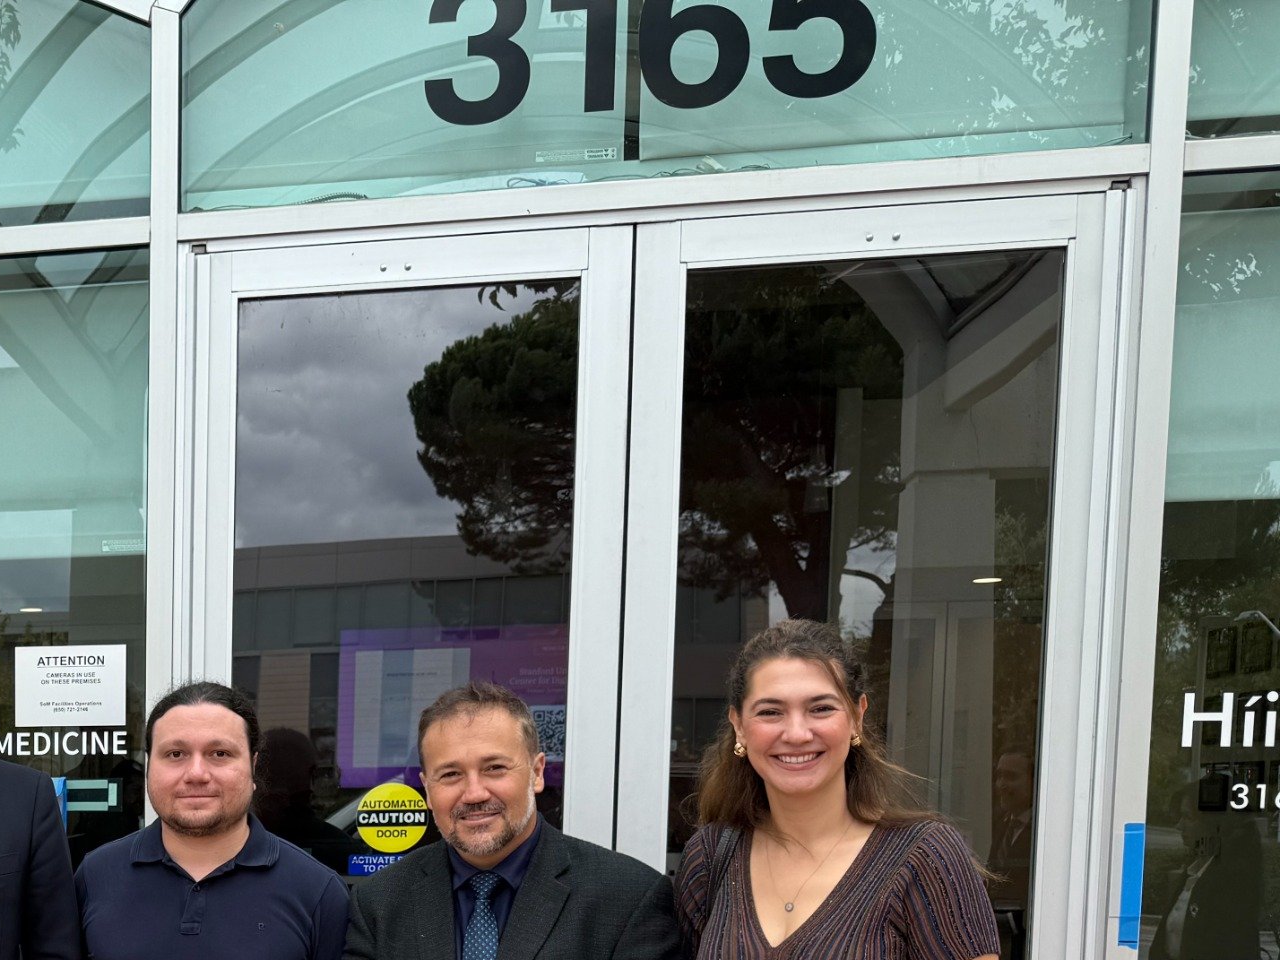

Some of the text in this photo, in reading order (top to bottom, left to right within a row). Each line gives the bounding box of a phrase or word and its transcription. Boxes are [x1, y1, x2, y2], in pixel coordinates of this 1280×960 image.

[424, 0, 878, 126] 3165
[37, 655, 105, 667] ATTENTION
[361, 799, 424, 809] AUTOMATIC
[358, 812, 426, 824] CAUTION
[376, 829, 408, 838] DOOR
[351, 856, 396, 864] ACTIVATE
[363, 865, 376, 873] TO
